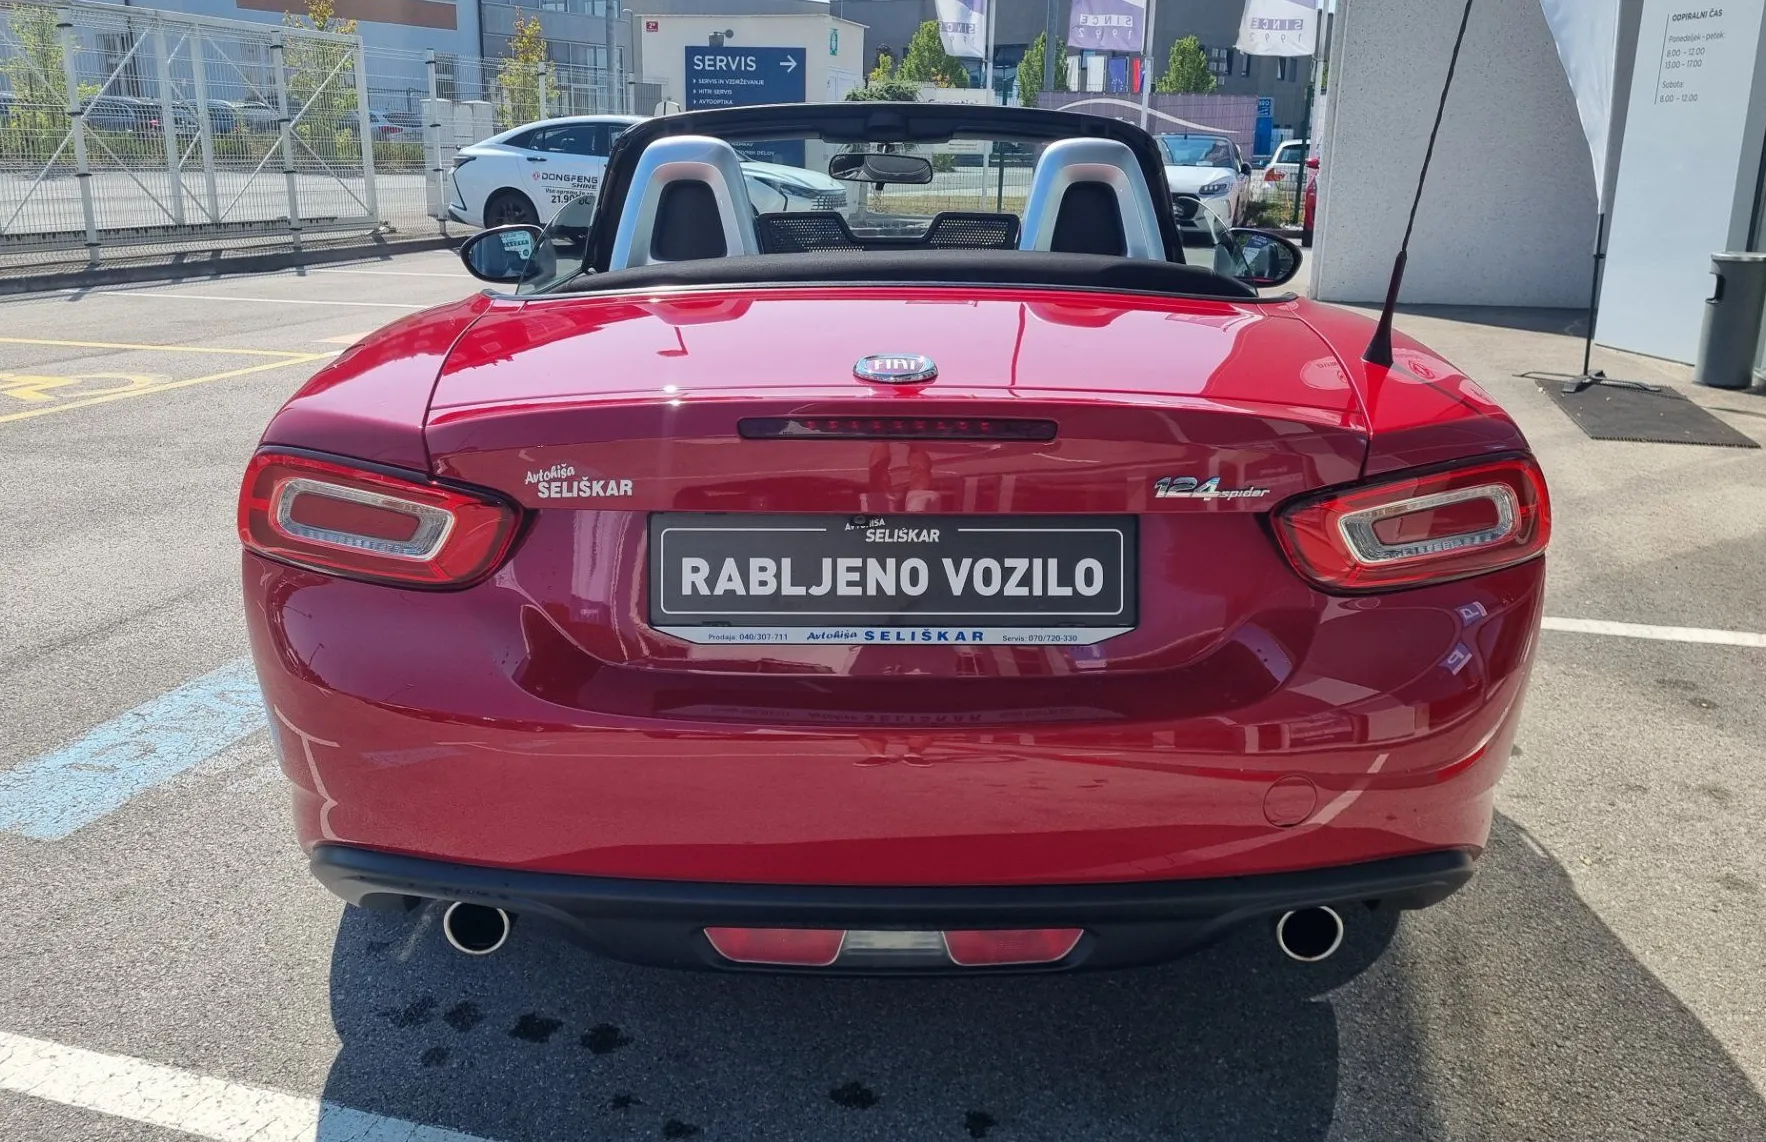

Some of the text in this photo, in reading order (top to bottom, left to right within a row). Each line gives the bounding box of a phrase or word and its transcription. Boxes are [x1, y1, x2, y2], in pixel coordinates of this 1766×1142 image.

[1672, 8, 1723, 21] ODPIRALNI ČAS
[693, 55, 756, 71] SERVIS
[541, 173, 598, 184] DONGFENG
[571, 182, 598, 190] SHINE
[874, 359, 916, 370] FIAT
[524, 463, 576, 485] Avtohiša
[537, 476, 633, 498] SELIŠKAR
[1154, 476, 1271, 501] 124 spider
[865, 527, 940, 543] SELIŠKAR
[681, 557, 1104, 596] RABLJENO VOZILO
[708, 628, 1078, 642] Prodaja: 040/307-711 Avtohiša SELIŠKAR Servis: 070/720-330
